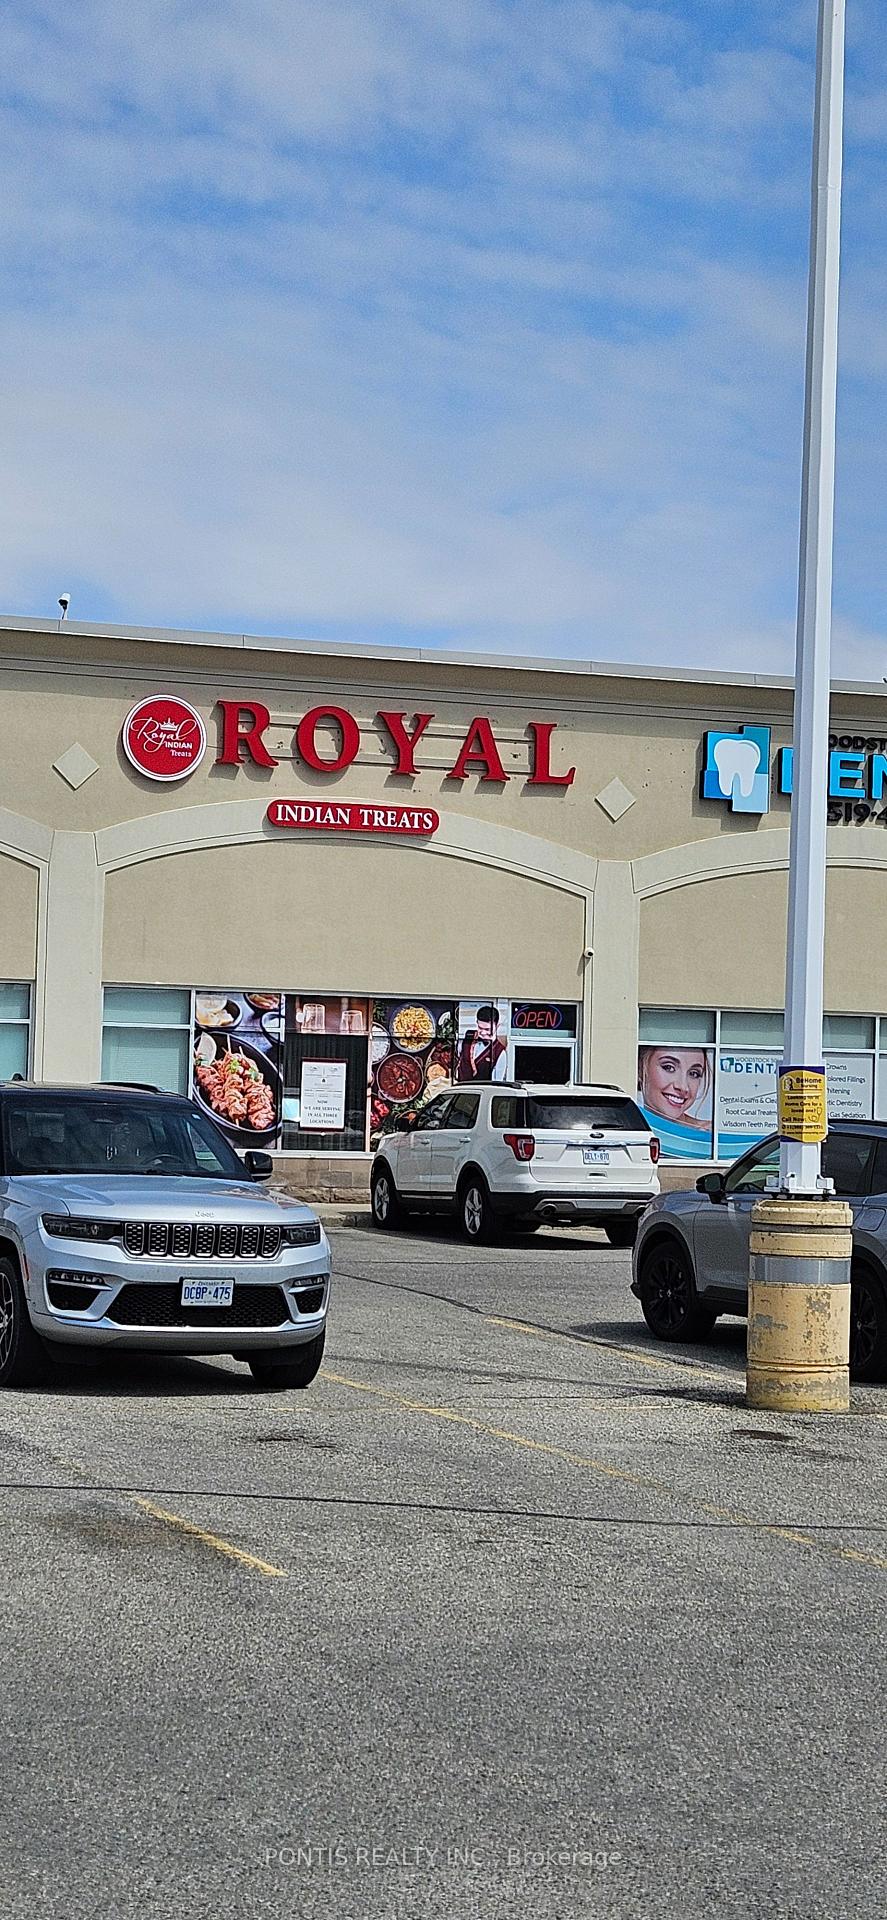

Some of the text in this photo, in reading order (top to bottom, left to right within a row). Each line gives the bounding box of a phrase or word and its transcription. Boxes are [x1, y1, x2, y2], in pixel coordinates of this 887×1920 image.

[130, 716, 197, 753] Royal
[214, 699, 576, 786] ROYAL
[170, 749, 192, 758] Treats
[276, 804, 433, 830] INDIAN TREATS
[515, 1011, 558, 1028] OPEN
[827, 1075, 866, 1084] olored Fillings
[827, 1087, 850, 1096] hitening
[836, 1100, 862, 1108] Dentistry
[184, 1286, 231, 1300] DCBP 475
